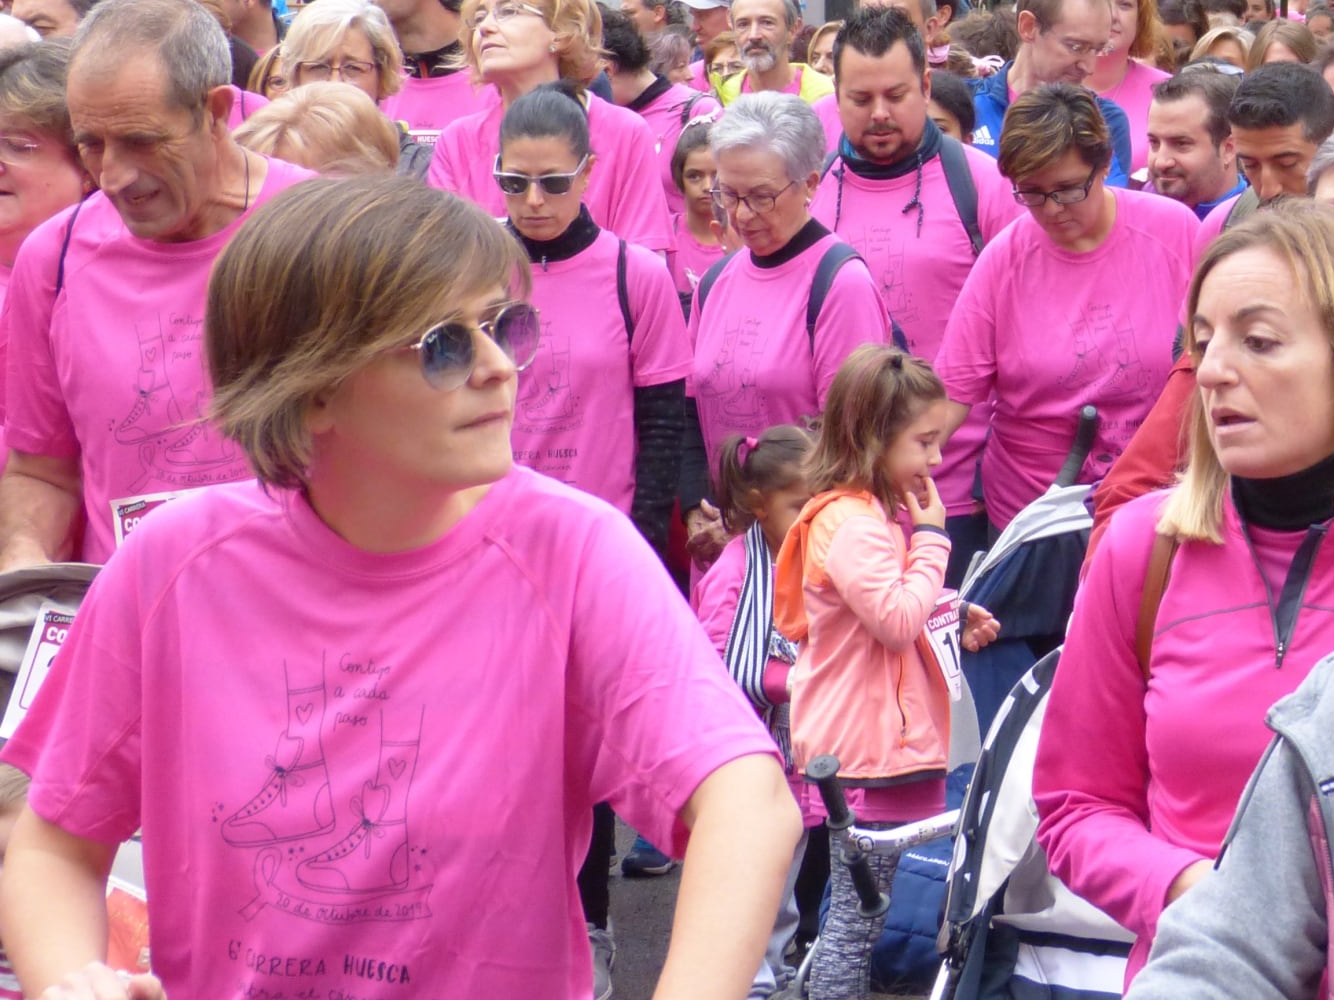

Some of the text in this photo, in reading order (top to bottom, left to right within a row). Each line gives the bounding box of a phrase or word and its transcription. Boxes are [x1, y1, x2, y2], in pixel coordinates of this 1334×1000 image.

[339, 652, 391, 680] Contigo
[334, 682, 390, 700] a cada
[334, 711, 368, 732] paso
[344, 954, 411, 985] HUESCA
